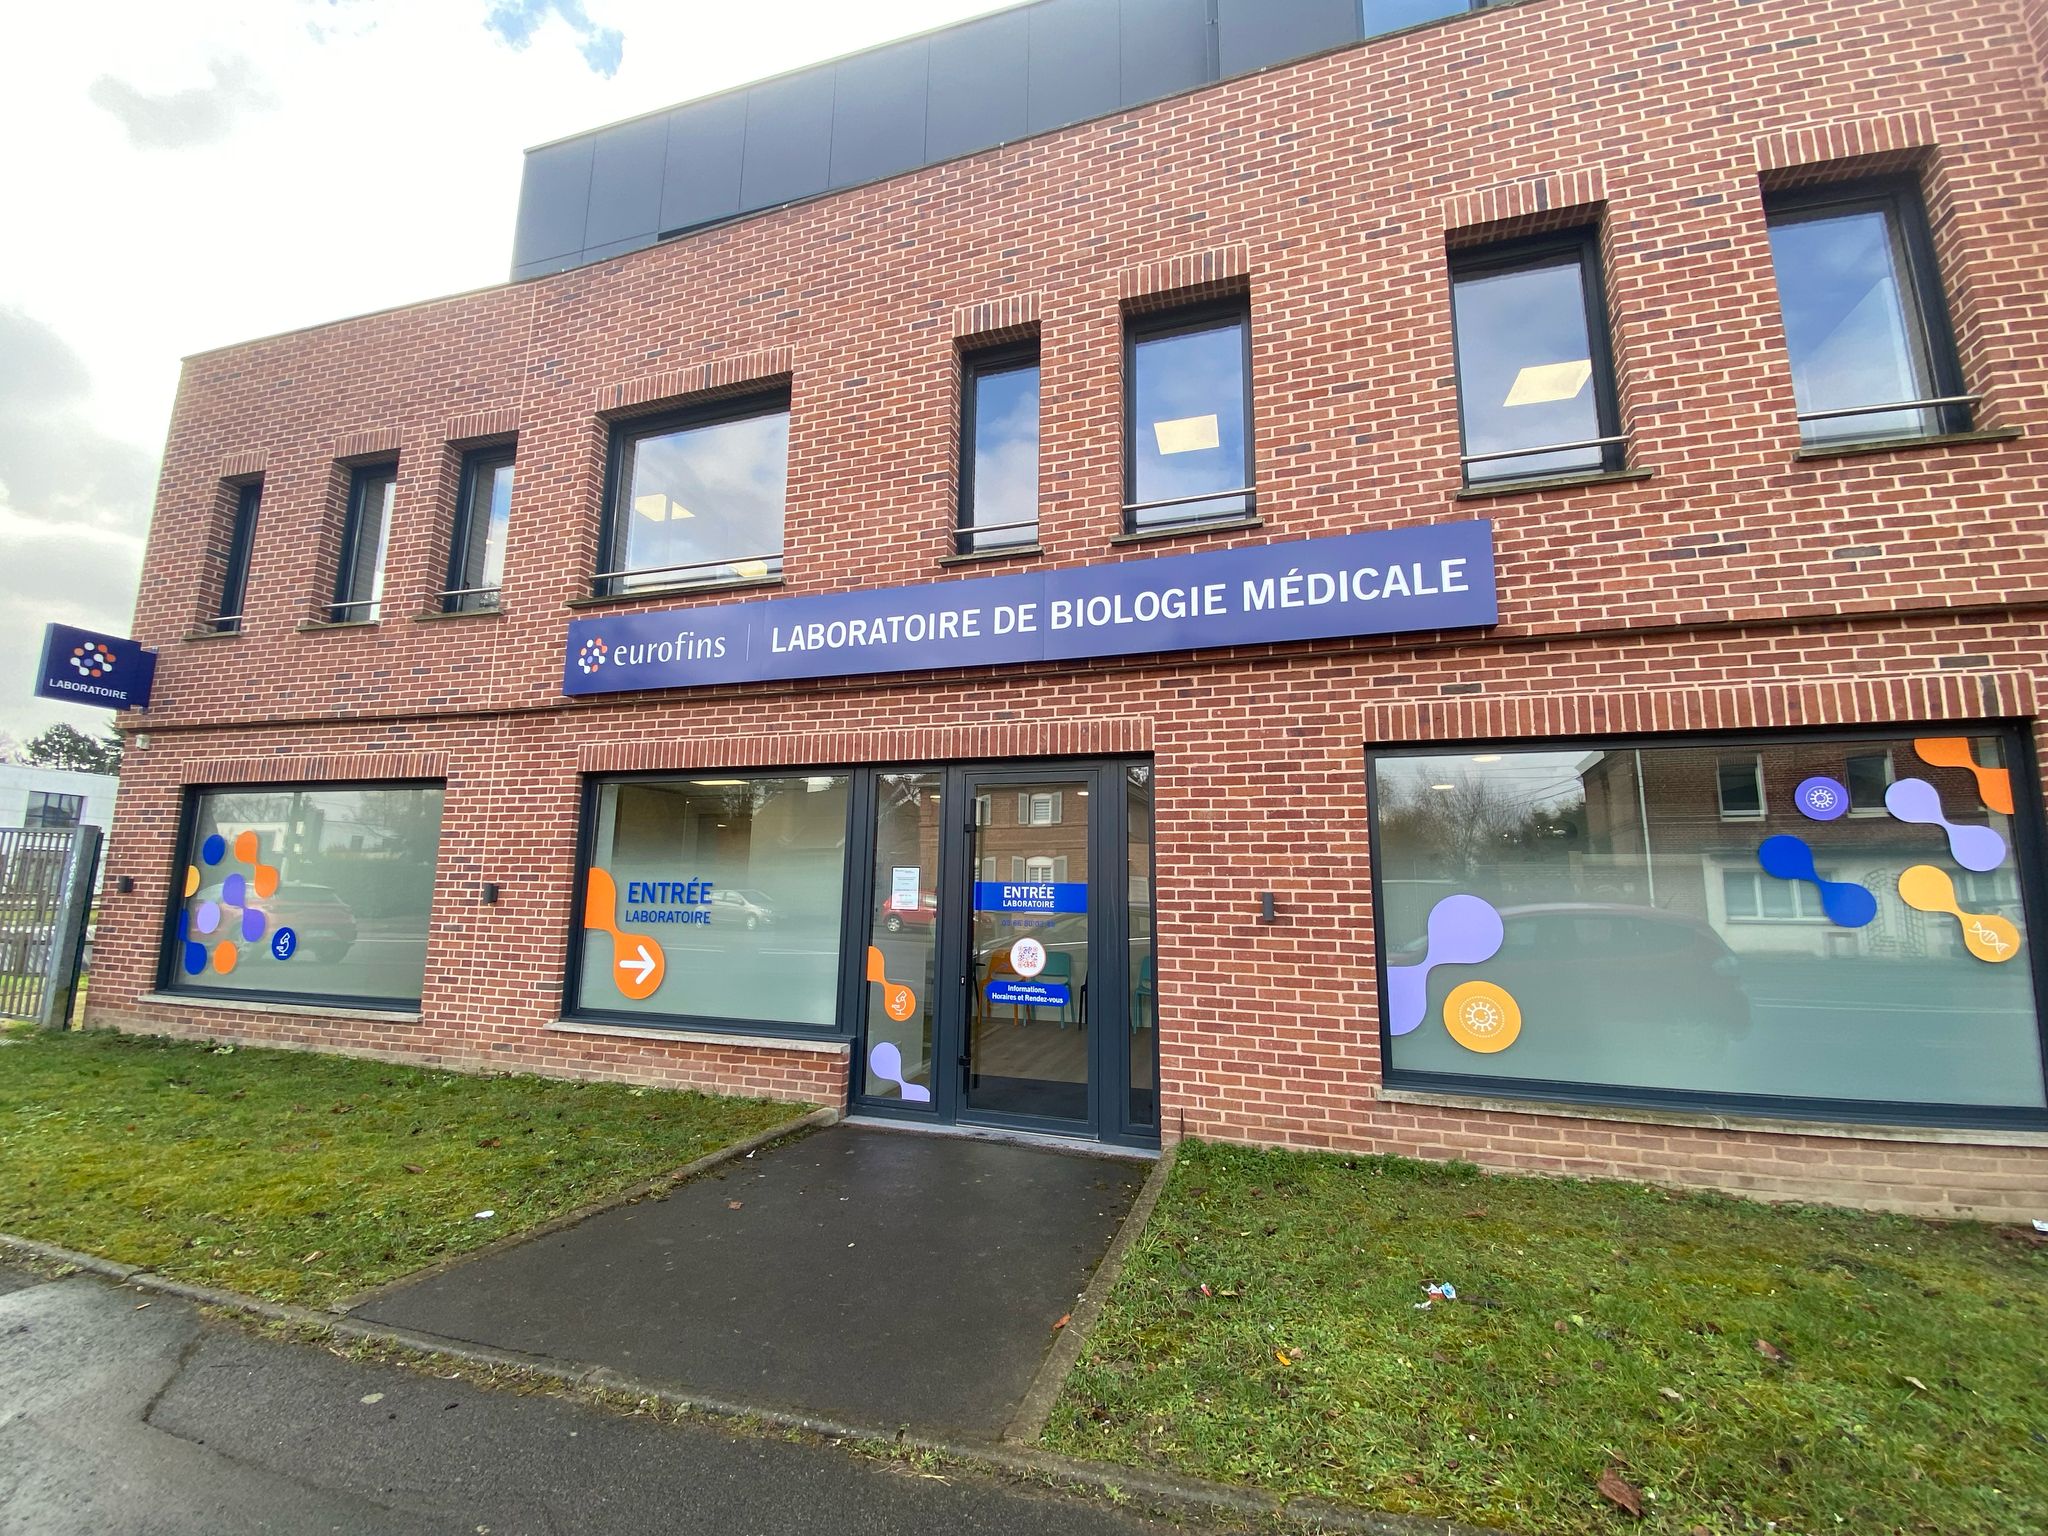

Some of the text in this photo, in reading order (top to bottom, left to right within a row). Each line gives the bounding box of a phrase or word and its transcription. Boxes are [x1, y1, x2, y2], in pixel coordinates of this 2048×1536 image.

[771, 558, 1469, 653] LABORATOIRE DE BIOLOGIE MÉDICALE
[614, 631, 726, 666] eurofins
[49, 678, 128, 700] LABORATOIRE
[627, 876, 713, 905] ENTRÉE
[1003, 884, 1055, 899] ENTRÉE
[1002, 900, 1055, 908] LABORATOIRE
[625, 909, 712, 925] LABORATOIRE
[1007, 984, 1047, 994] Informations,
[991, 992, 1017, 1001] Horaires
[1024, 994, 1064, 1004] Rendez-vous
